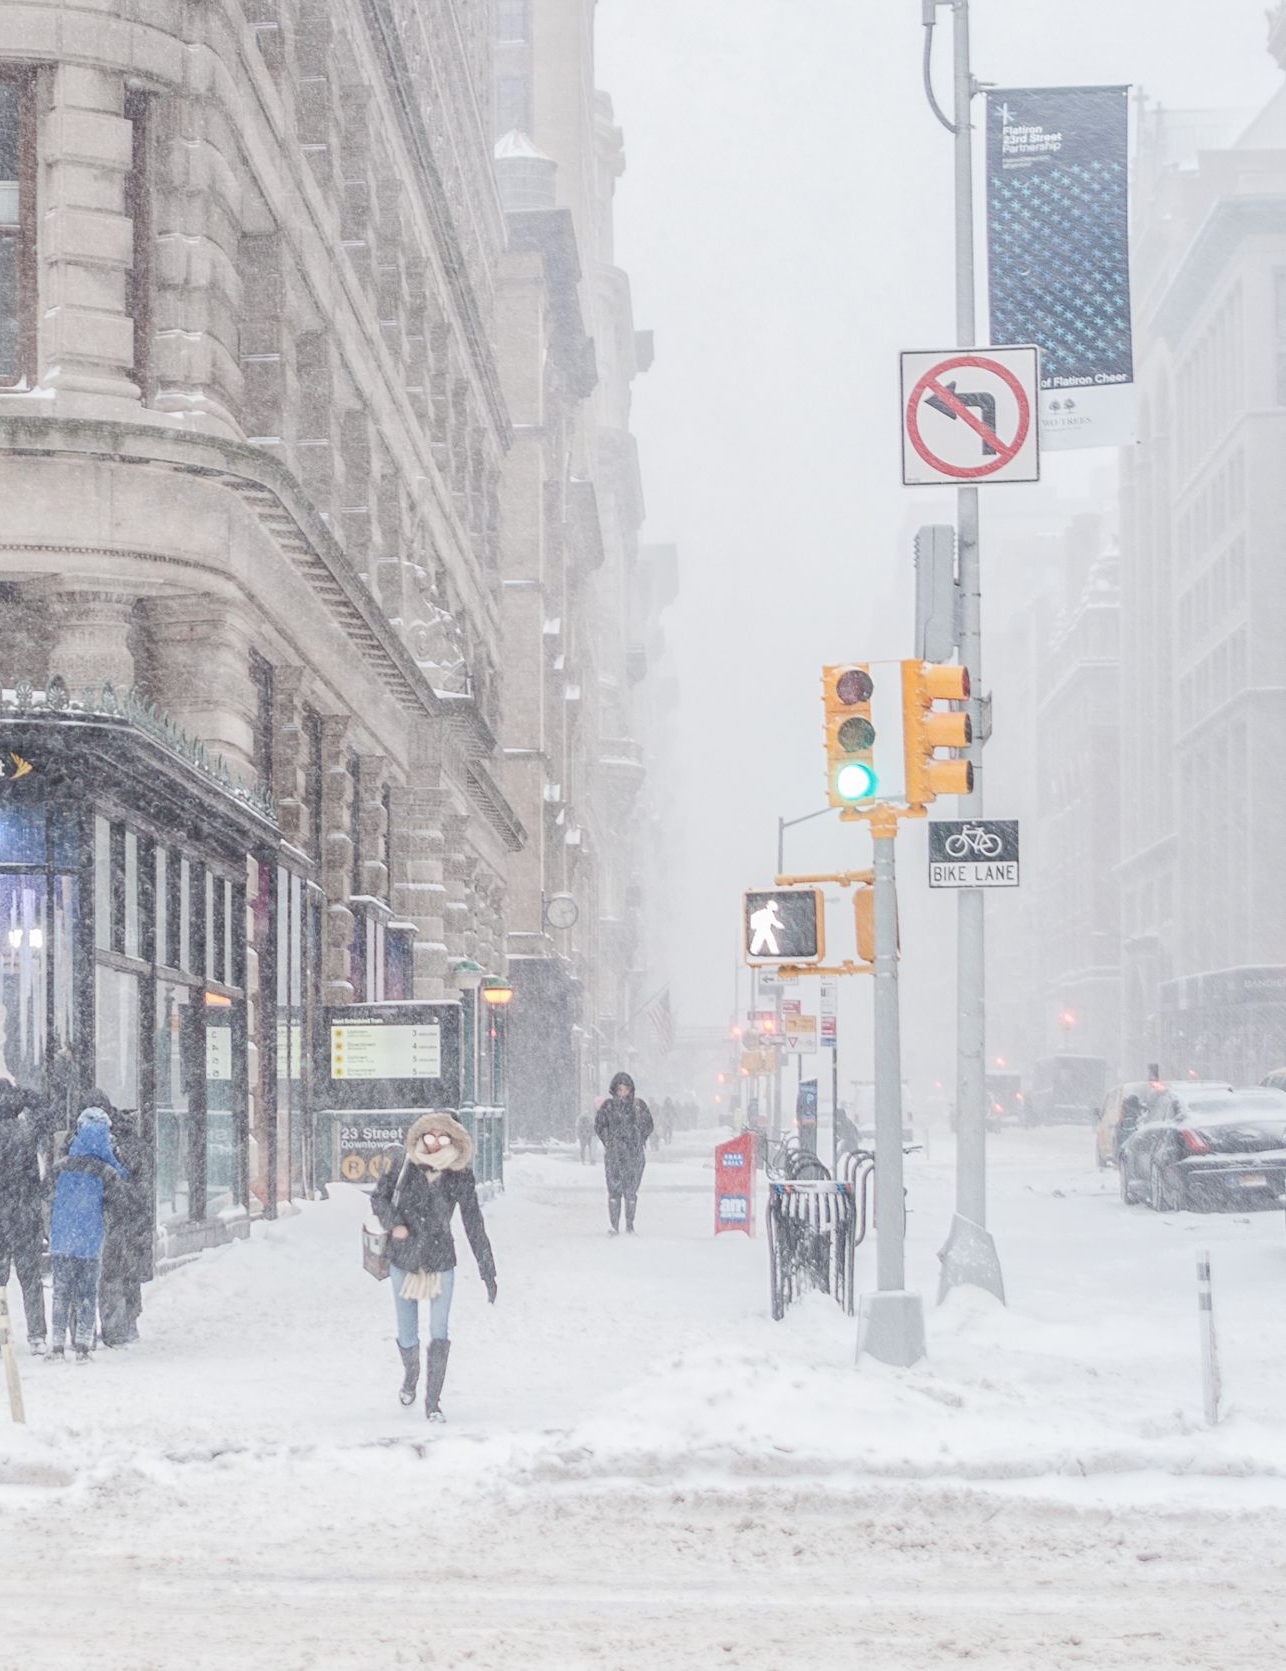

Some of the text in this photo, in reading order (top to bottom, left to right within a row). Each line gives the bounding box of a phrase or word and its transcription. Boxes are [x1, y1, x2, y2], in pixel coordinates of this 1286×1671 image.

[1003, 126, 1043, 136] Flatiron
[1003, 132, 1062, 144] 23rd Street
[1002, 141, 1062, 154] Partnership
[1041, 373, 1127, 388] of Flatiron Cheer
[934, 865, 1015, 882] BIKE LANE
[341, 1127, 404, 1140] 23 Street
[348, 1160, 360, 1175] R
